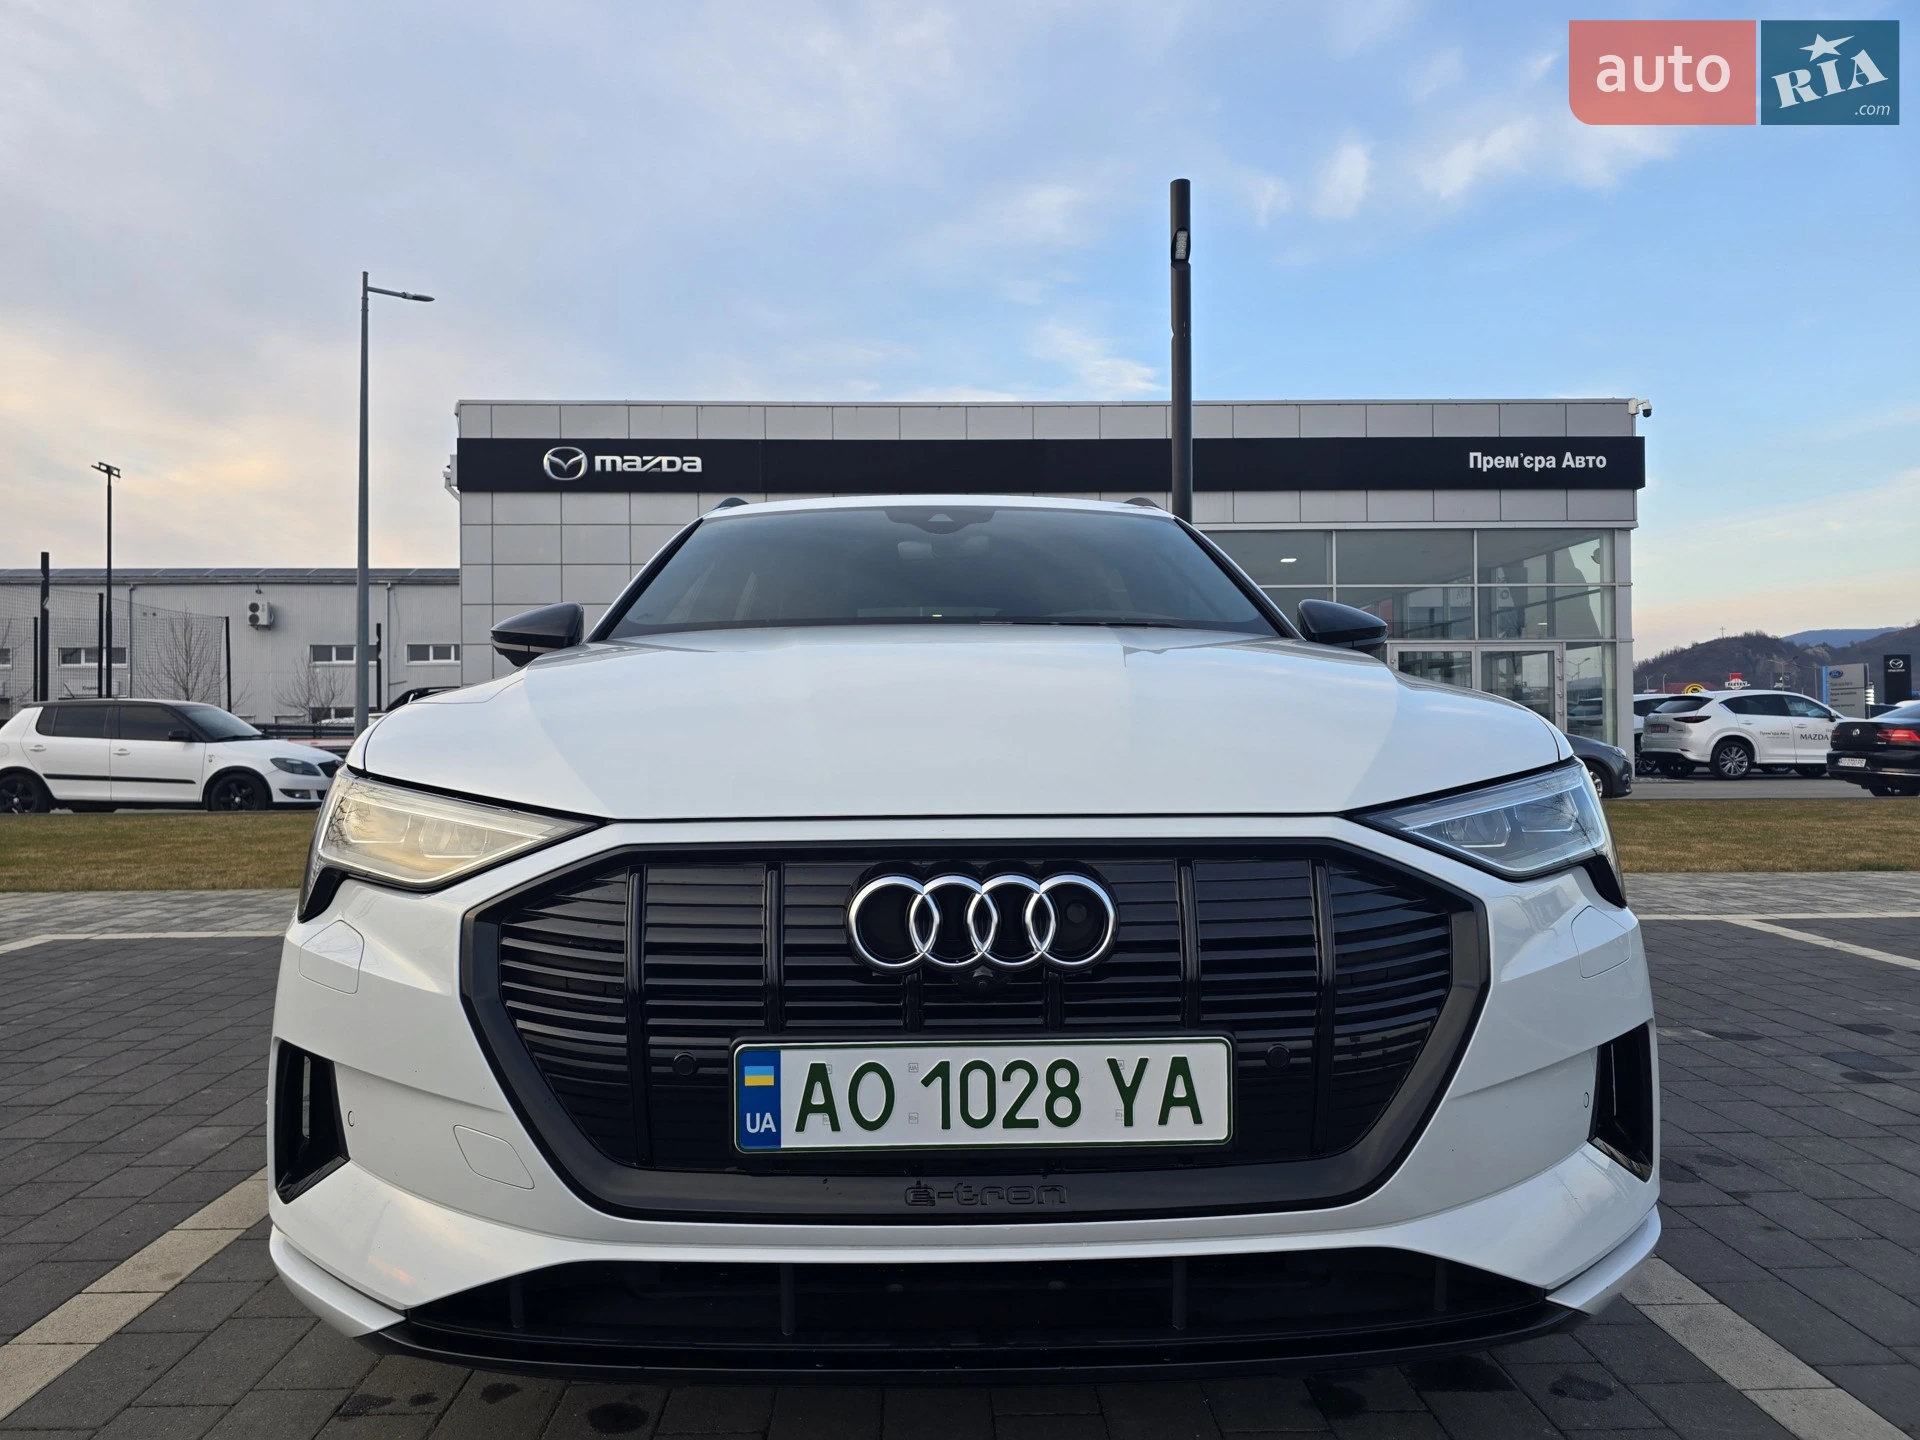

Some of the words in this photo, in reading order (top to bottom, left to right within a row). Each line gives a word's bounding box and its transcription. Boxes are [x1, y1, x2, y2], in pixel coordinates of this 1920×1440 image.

[1469, 451, 1556, 472] Прем'єра
[1561, 451, 1607, 469] Авто
[1799, 733, 1830, 741] MAZDA
[795, 1061, 896, 1132] AO
[920, 1058, 1082, 1130] 1028
[1106, 1056, 1203, 1128] YA
[745, 1111, 777, 1134] UA
[904, 1182, 1068, 1207] e-tron
